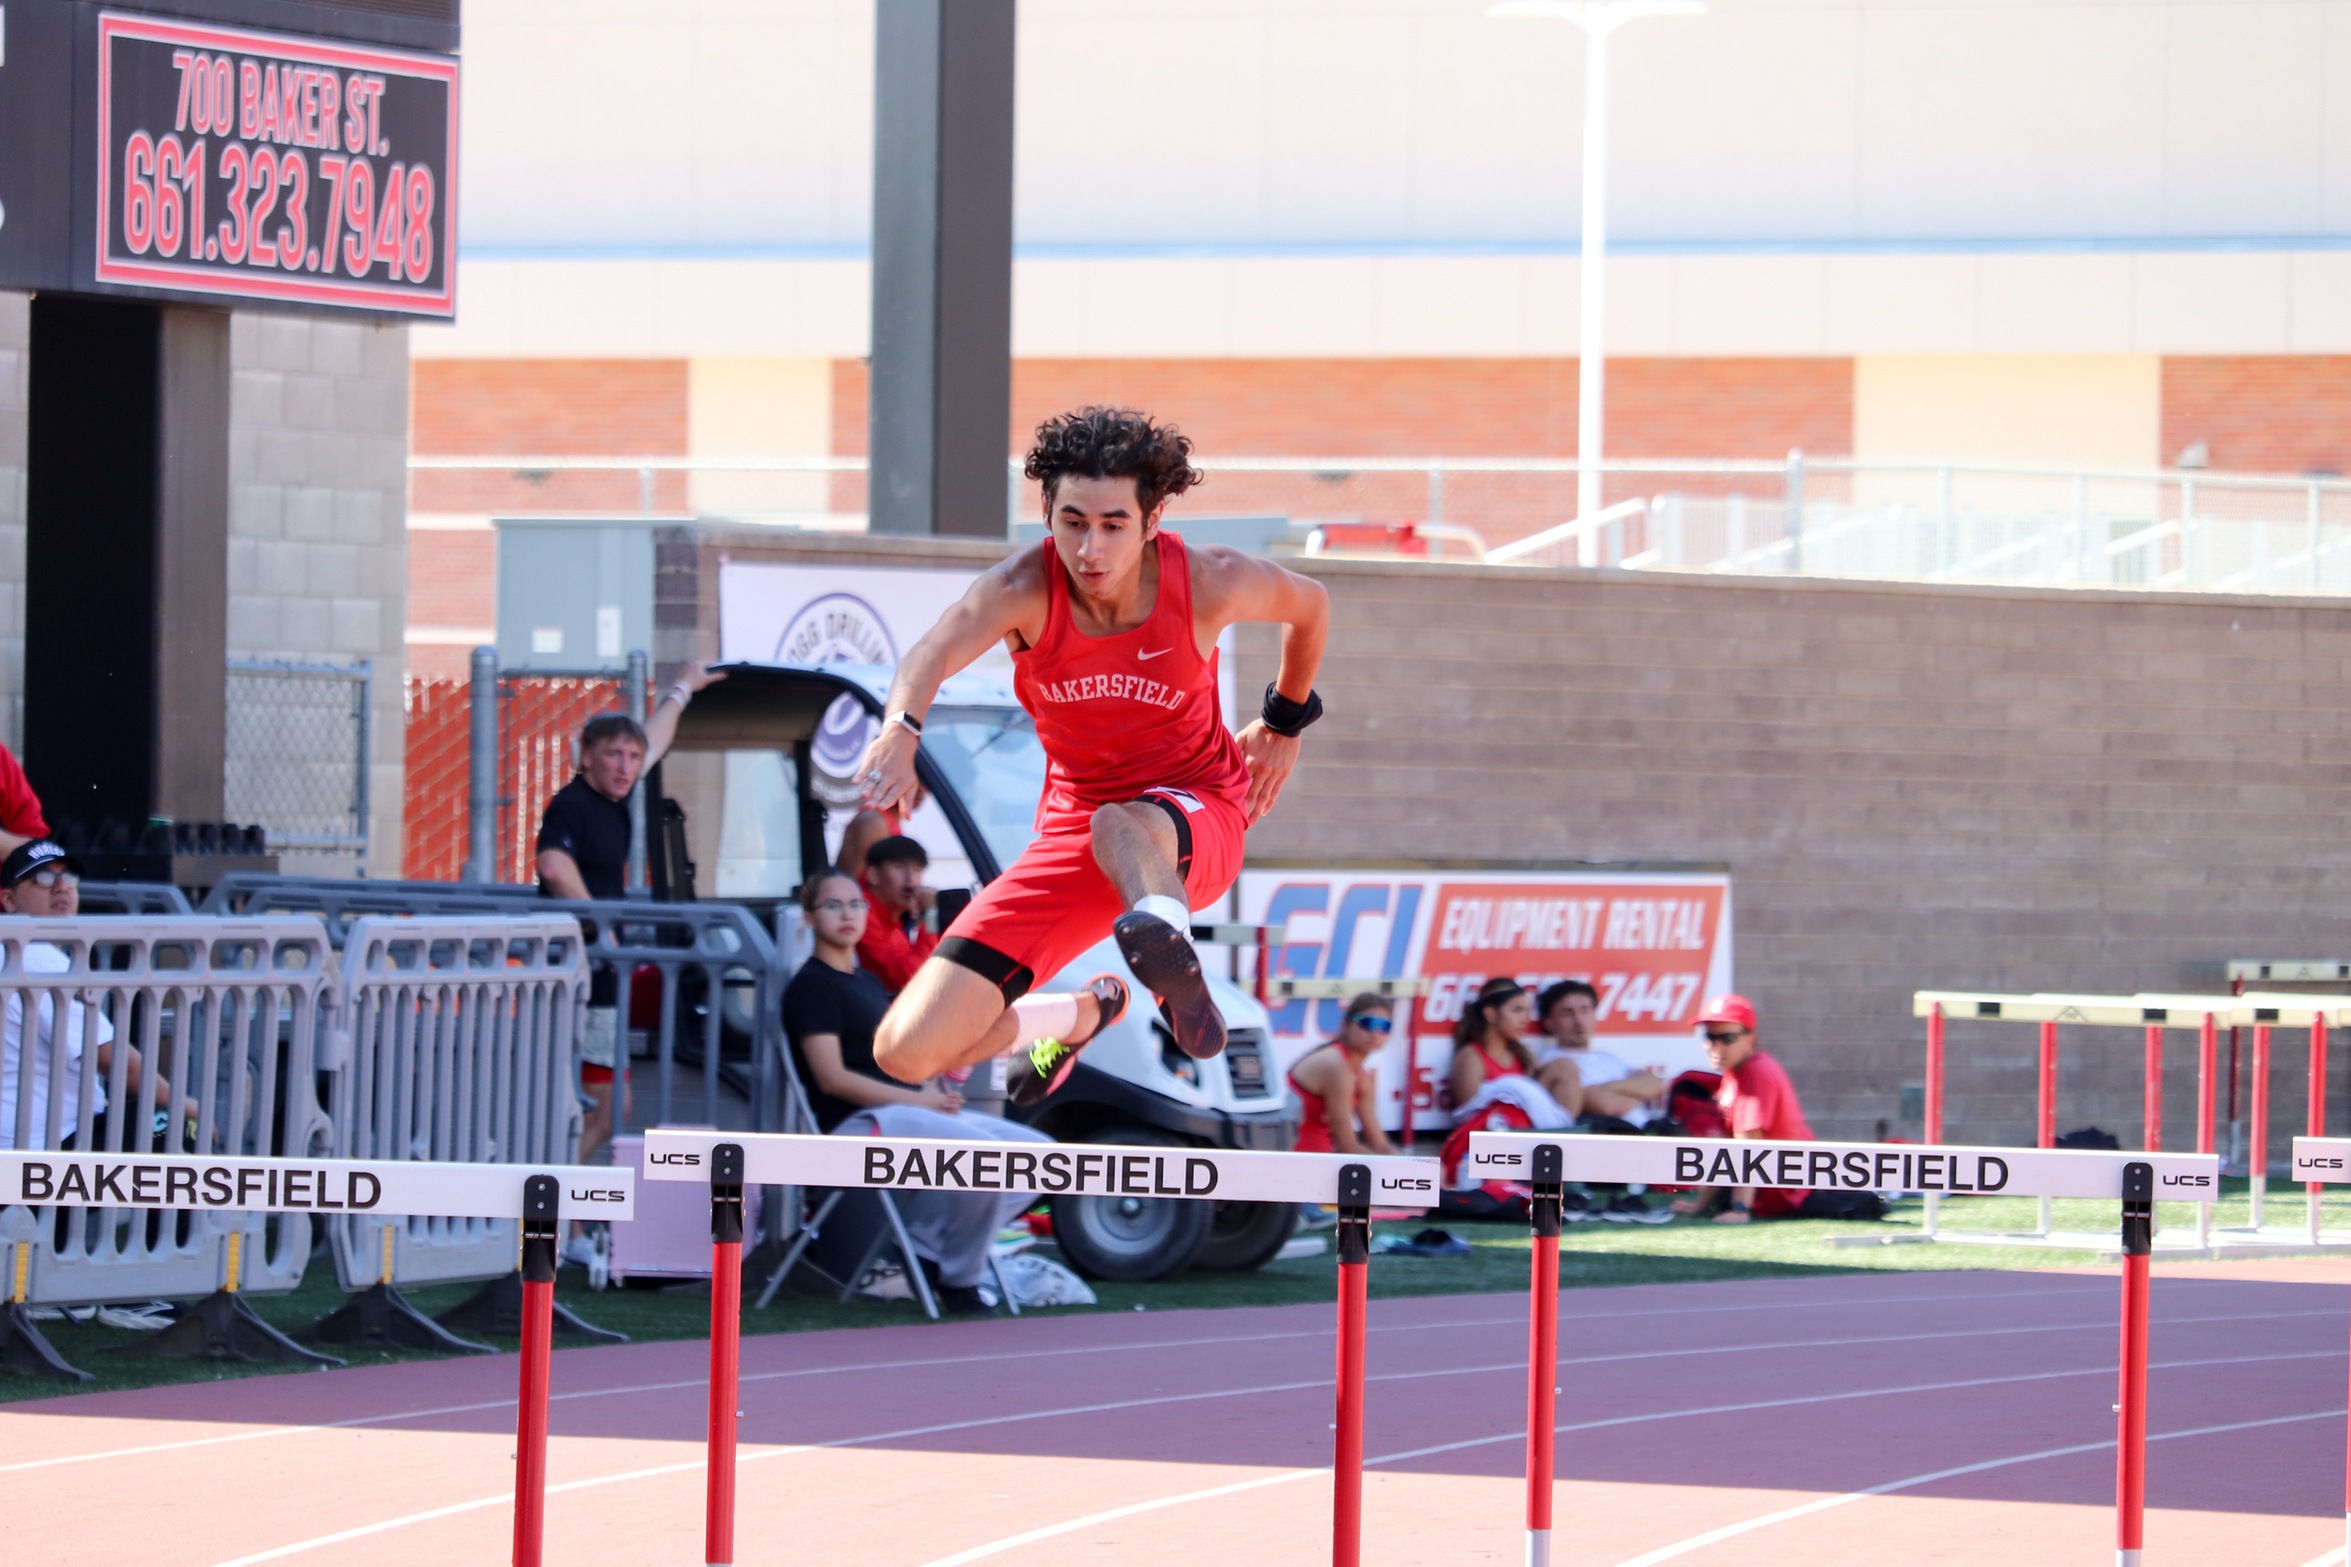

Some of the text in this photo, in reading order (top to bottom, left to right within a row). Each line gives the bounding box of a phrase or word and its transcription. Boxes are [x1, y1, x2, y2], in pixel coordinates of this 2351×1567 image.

[172, 48, 391, 157] 700 BAKER ST.
[123, 129, 435, 284] 661.323.7948
[1038, 673, 1186, 711] BAKERSFIELD
[1438, 896, 1706, 954] EQUIPMENT RENTAL
[1596, 973, 1700, 1022] 7447
[650, 1153, 701, 1166] UCS
[864, 1146, 1219, 1196] BAKERSFIELD
[1475, 1153, 1522, 1165] UCS
[1675, 1146, 2009, 1191] BAKERSFIELD
[2298, 1158, 2343, 1169] UCS
[21, 1162, 382, 1210] BAKERSFIELD
[570, 1189, 626, 1202] UCS
[1381, 1178, 1432, 1191] UCS
[2162, 1175, 2211, 1187] UCS
